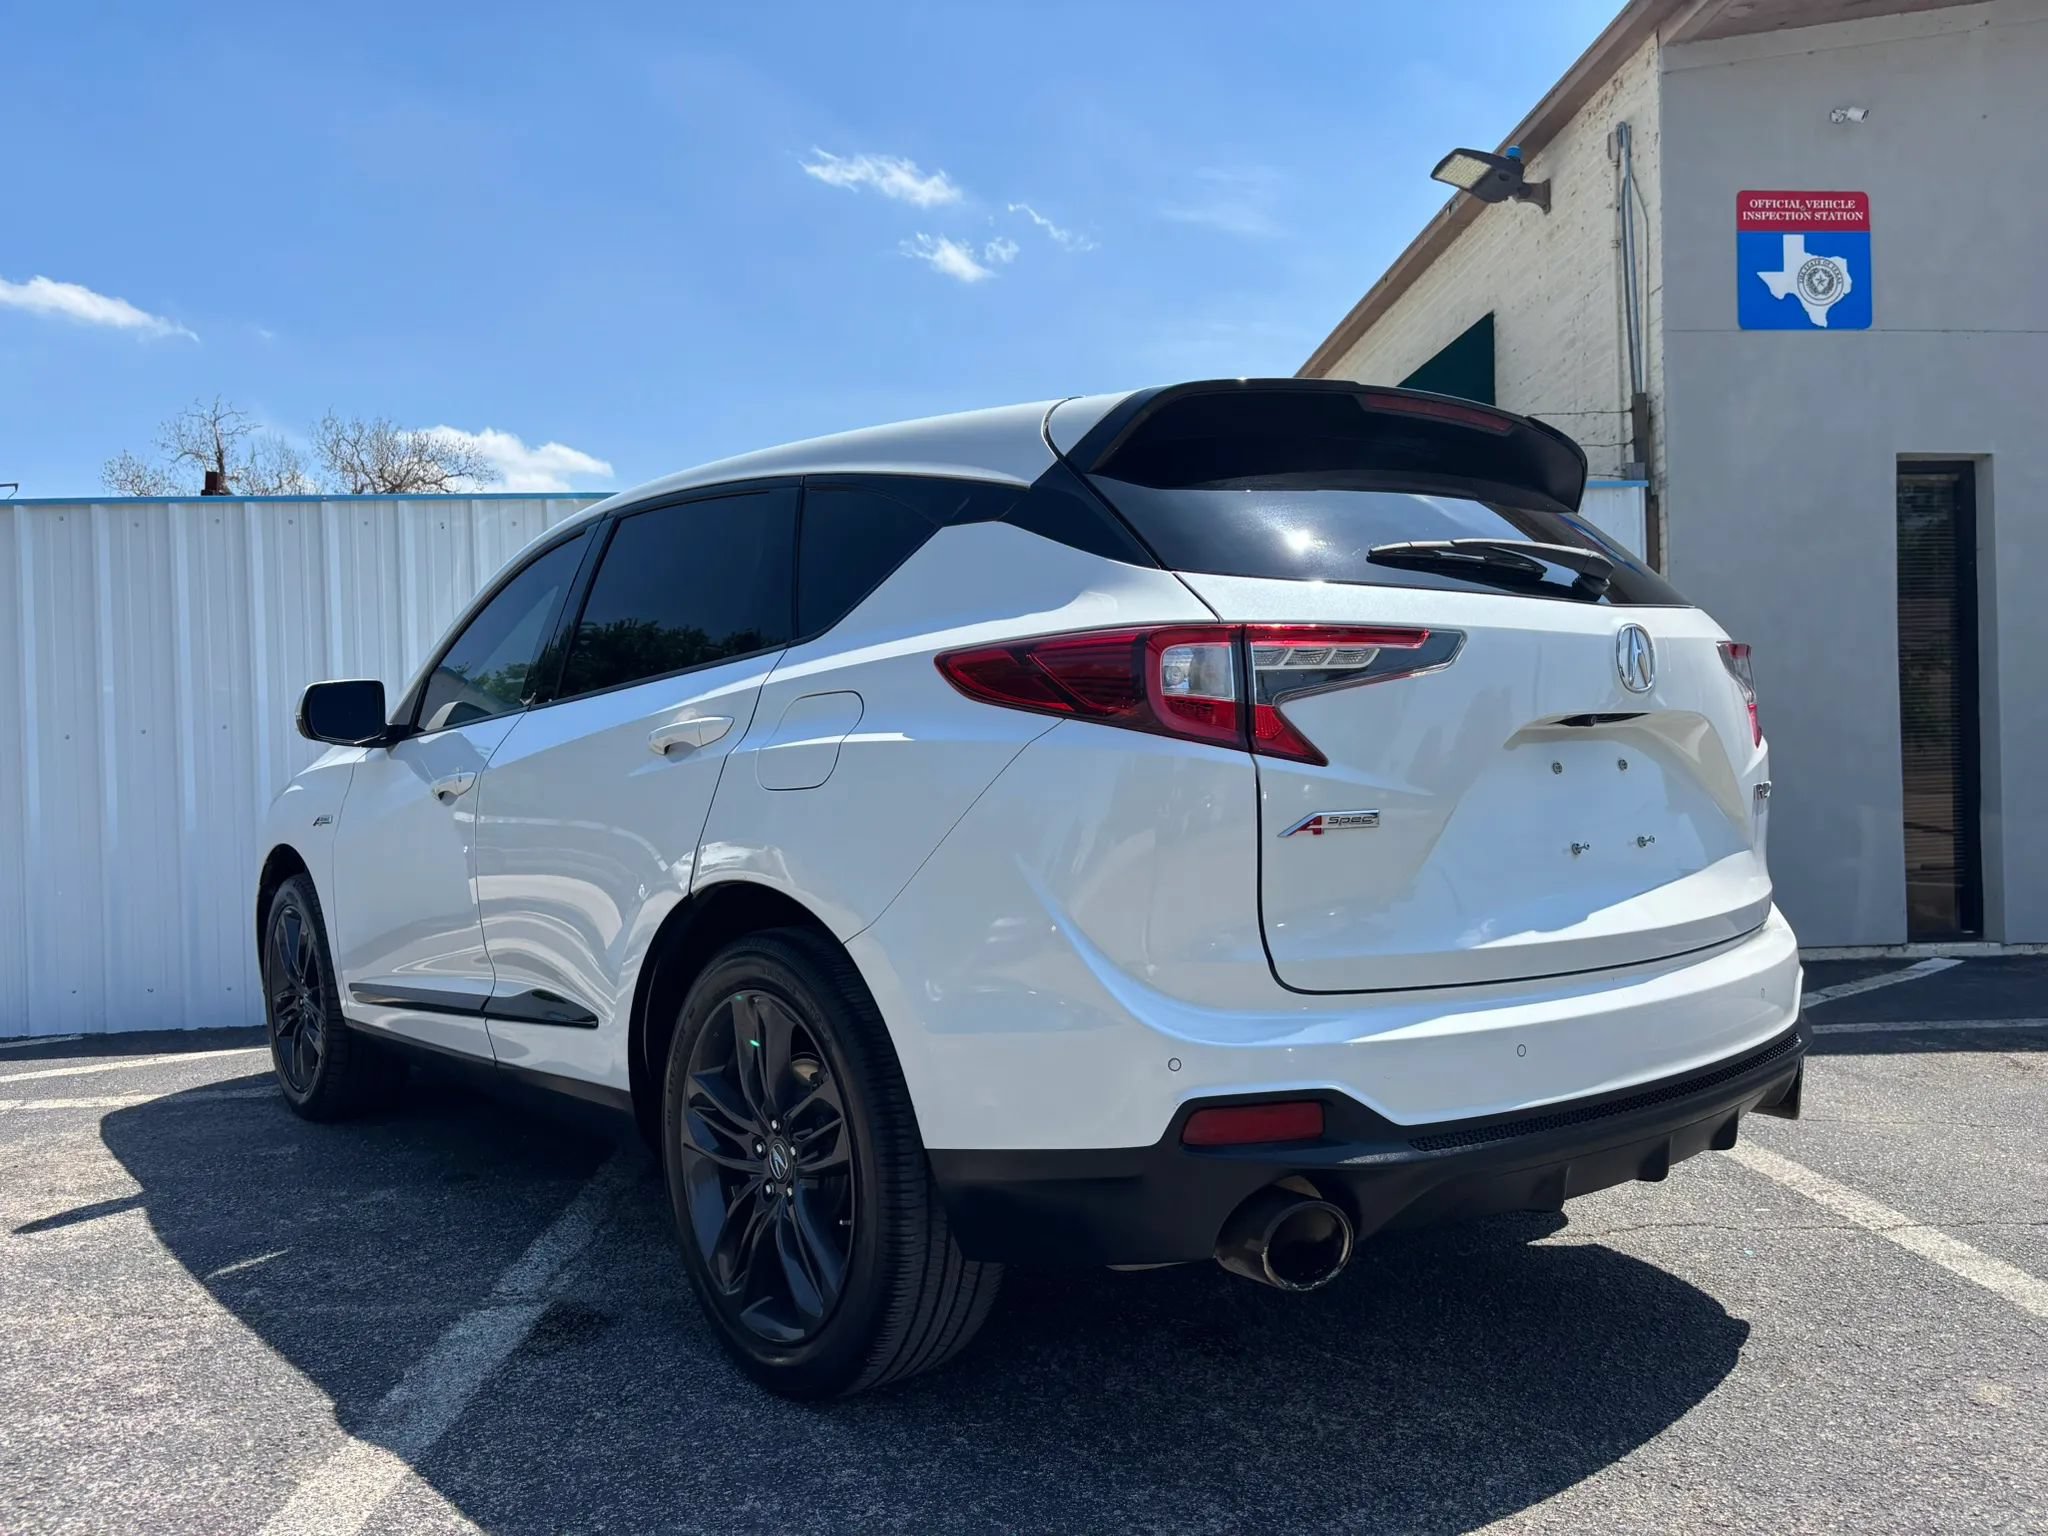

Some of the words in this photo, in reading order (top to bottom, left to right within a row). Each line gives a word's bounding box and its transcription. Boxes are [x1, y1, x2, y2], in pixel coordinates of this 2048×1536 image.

[1749, 199, 1802, 209] OFFICIAL
[1805, 200, 1856, 209] VEHICLE
[1743, 211, 1812, 221] INSPECTION
[1814, 211, 1864, 221] STATION
